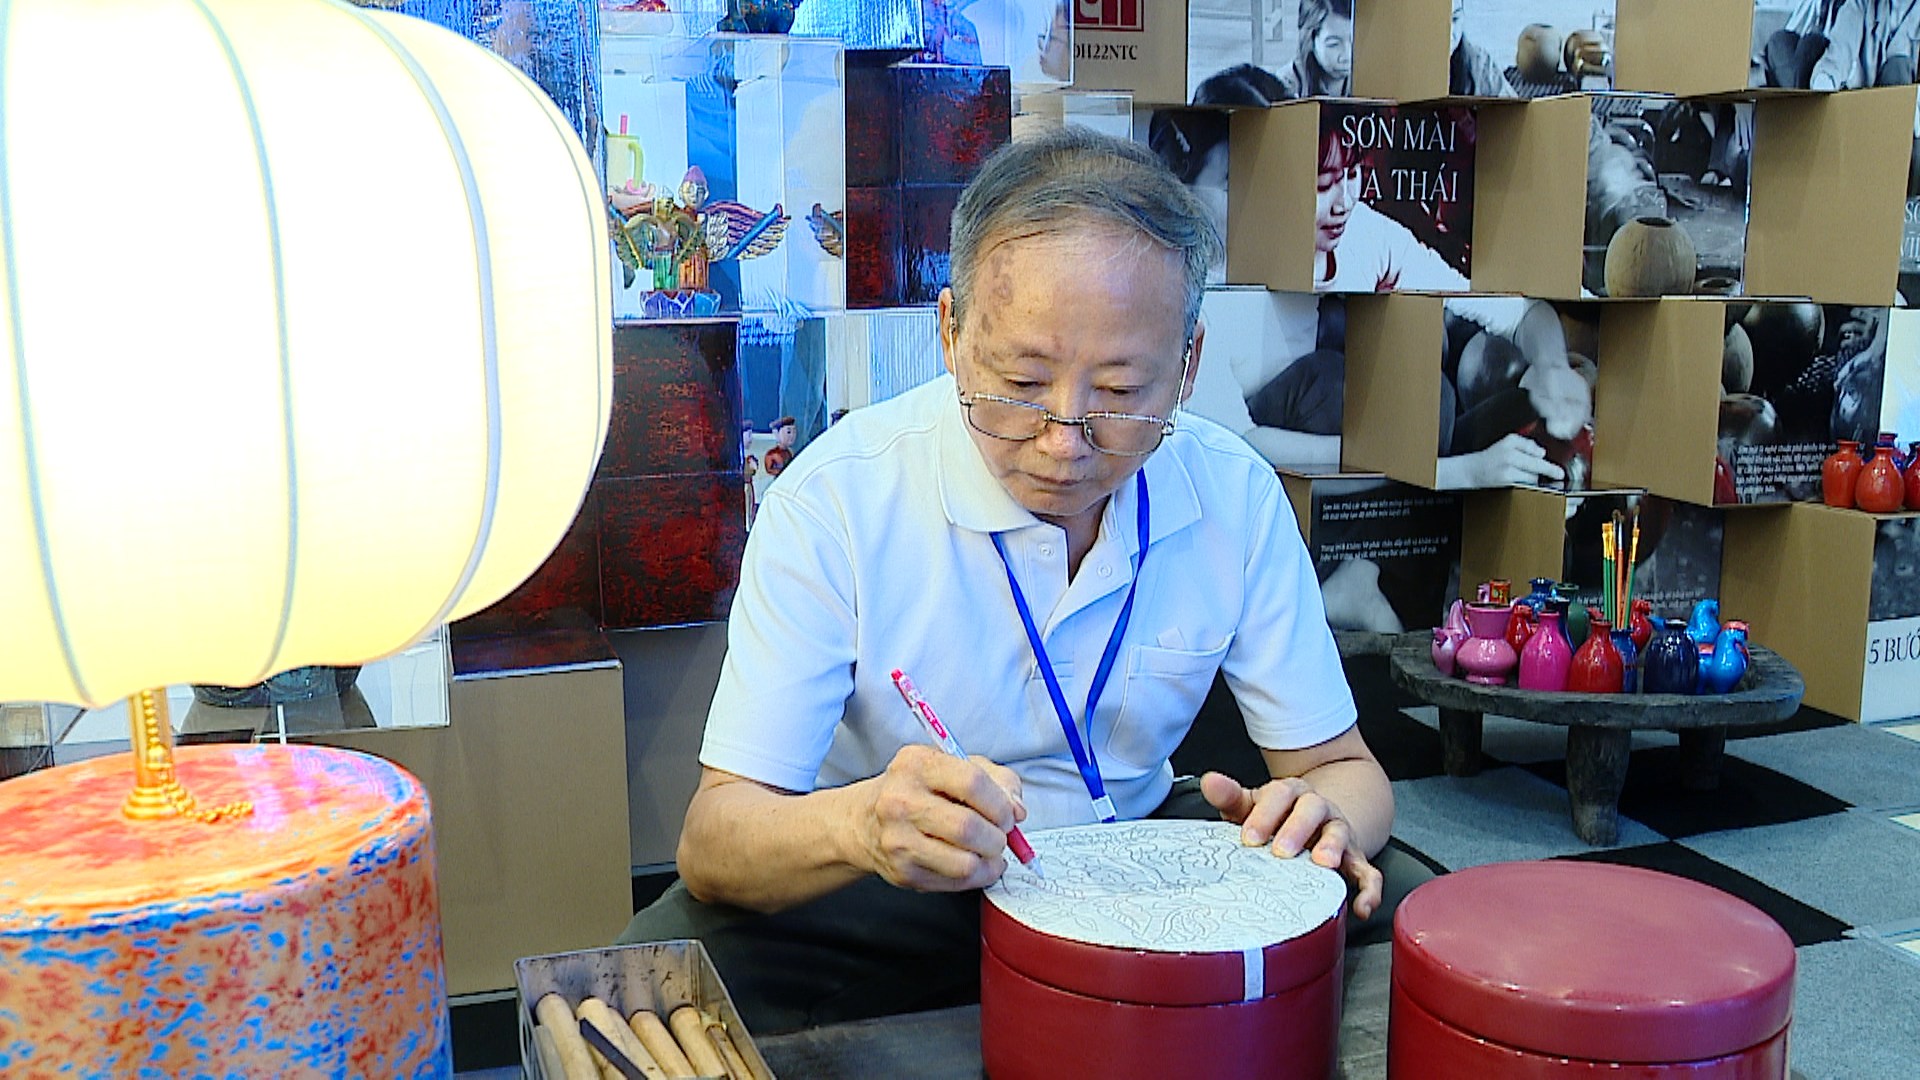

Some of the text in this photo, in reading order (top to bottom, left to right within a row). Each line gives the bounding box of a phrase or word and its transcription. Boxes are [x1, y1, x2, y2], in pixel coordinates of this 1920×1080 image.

[1403, 111, 1457, 153] MÀI
[1391, 163, 1458, 202] THÁI
[1868, 639, 1880, 664] 5
